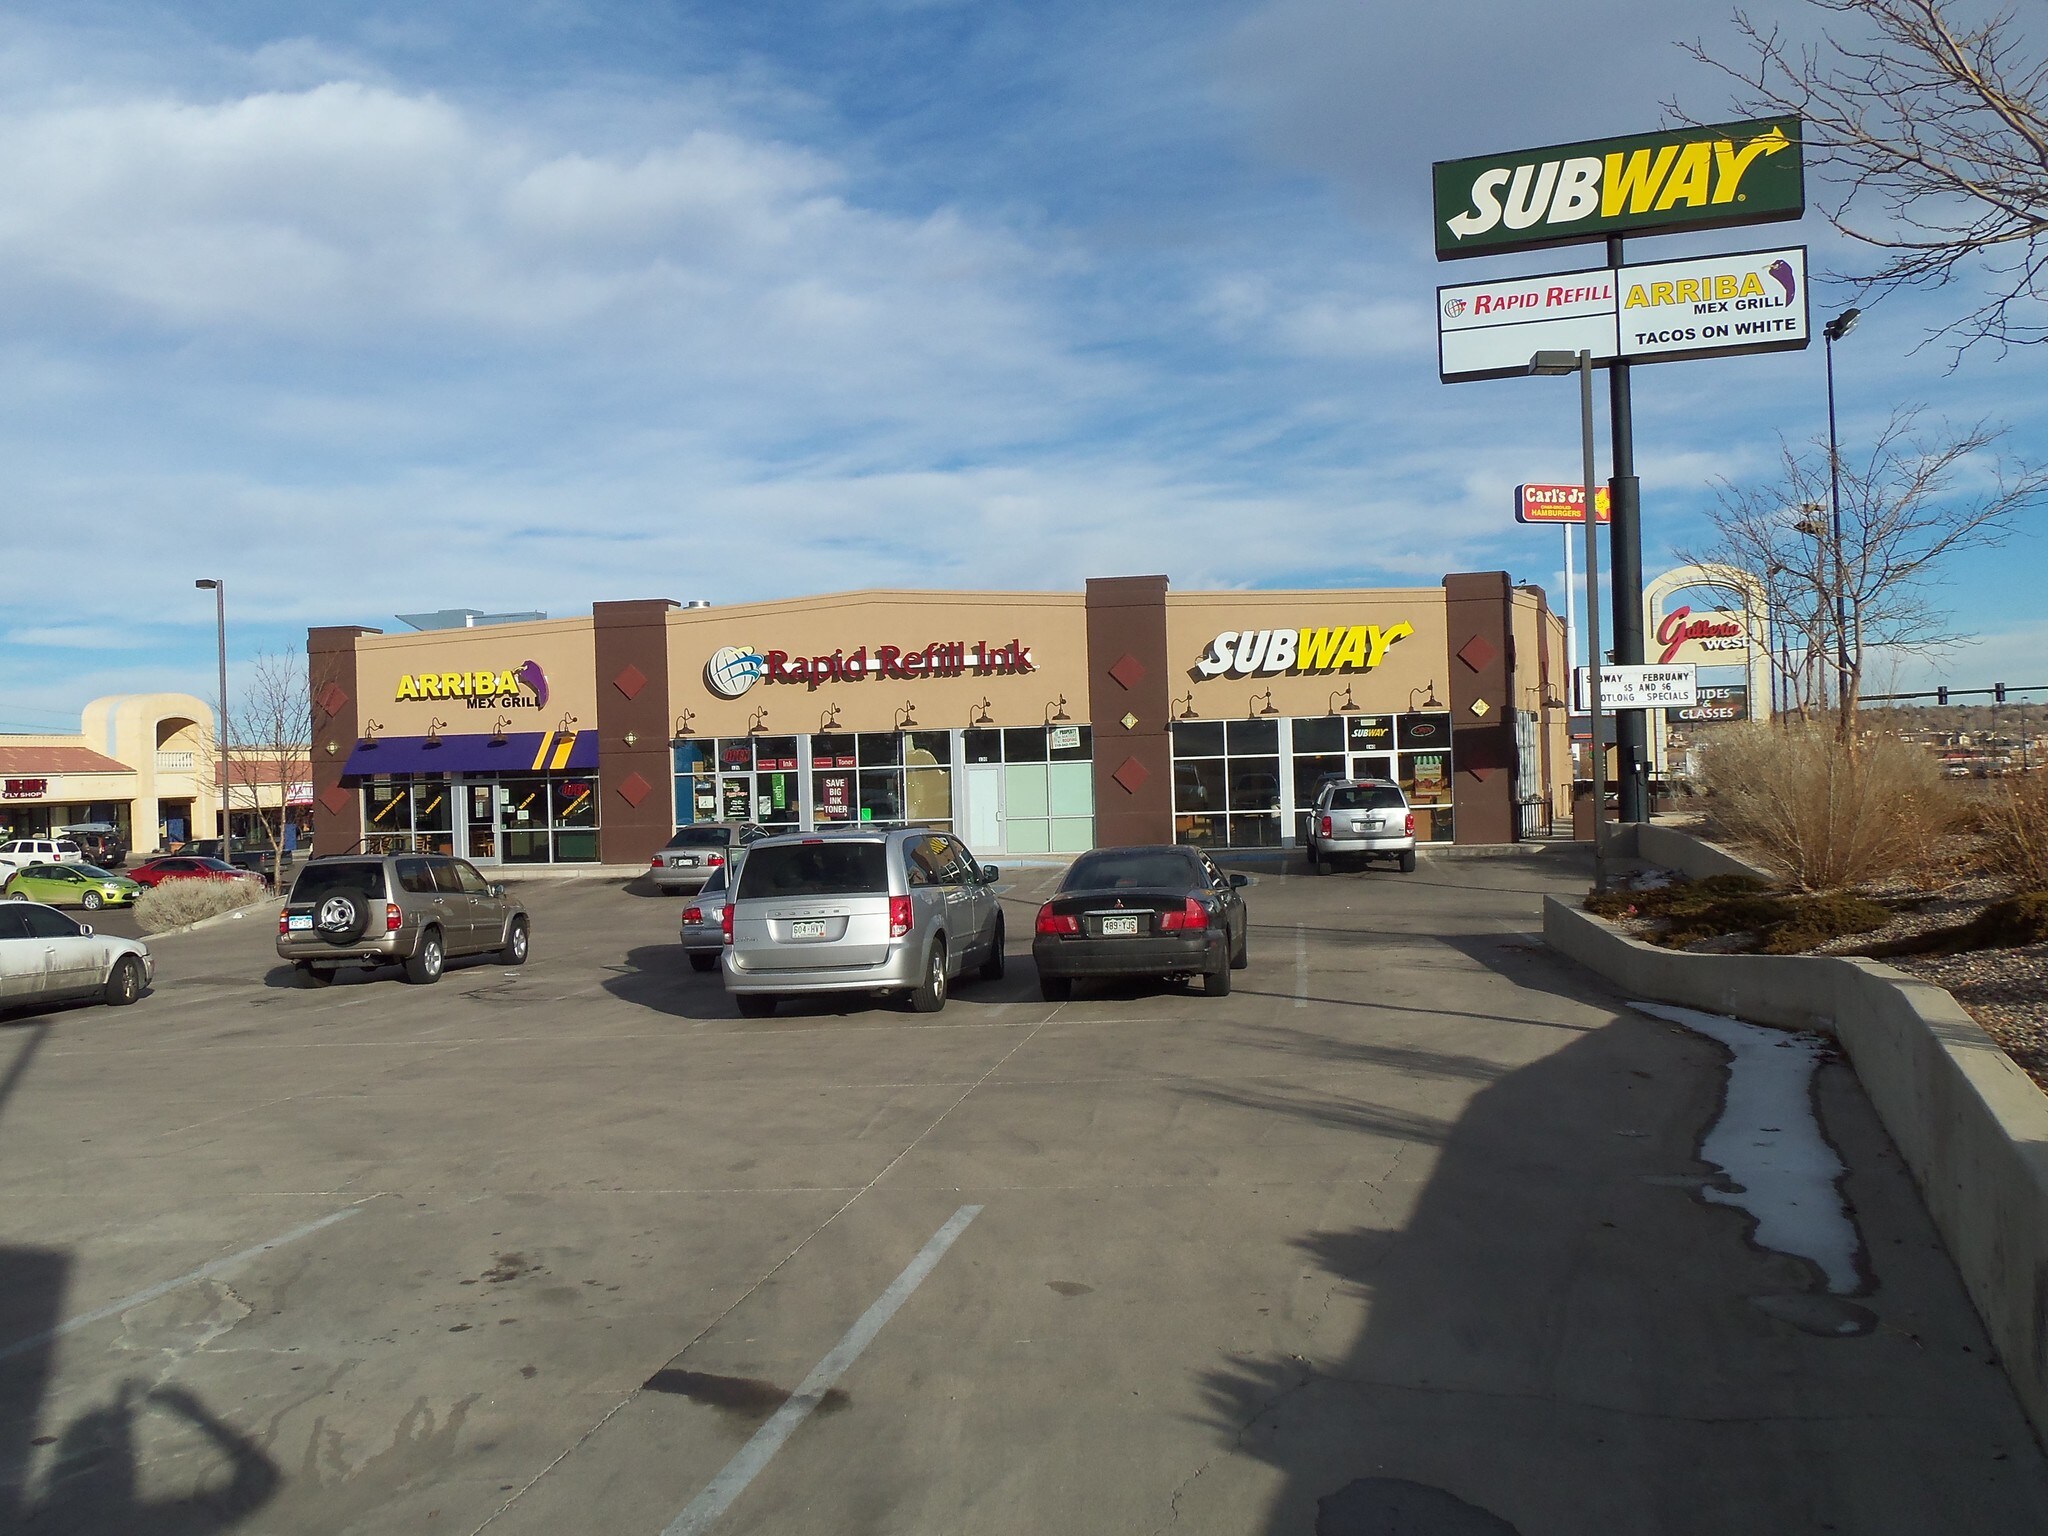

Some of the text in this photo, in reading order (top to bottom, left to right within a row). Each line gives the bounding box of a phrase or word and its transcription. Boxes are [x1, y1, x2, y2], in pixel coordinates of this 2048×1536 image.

[1446, 126, 1790, 240] SUBWAY
[1624, 272, 1765, 309] ARRIBA
[1474, 284, 1612, 315] RAPID REFILL
[1693, 296, 1783, 315] MEX GRILL
[1635, 319, 1796, 345] TACOS ON WHITE
[1526, 487, 1566, 503] Carl's
[1531, 509, 1582, 517] HAMBURGERS
[1657, 606, 1741, 664] Galleria
[1196, 620, 1415, 677] SUBWAY
[768, 639, 1036, 687] Rapid Refill Ink
[1586, 674, 1623, 683] SBWAY
[397, 670, 520, 700] ARRIBA
[1624, 682, 1671, 692] $5 AND $6
[1600, 692, 1689, 702] OTLONG SPECIALS
[466, 697, 541, 709] MEX GRILL
[1679, 708, 1734, 719] CLASSES
[1351, 728, 1389, 738] SUBWAY
[826, 779, 845, 787] SAVE
[829, 788, 842, 796] BIG
[829, 796, 842, 804] INK
[824, 805, 848, 814] TONER
[1105, 921, 1136, 930] 489-YJS
